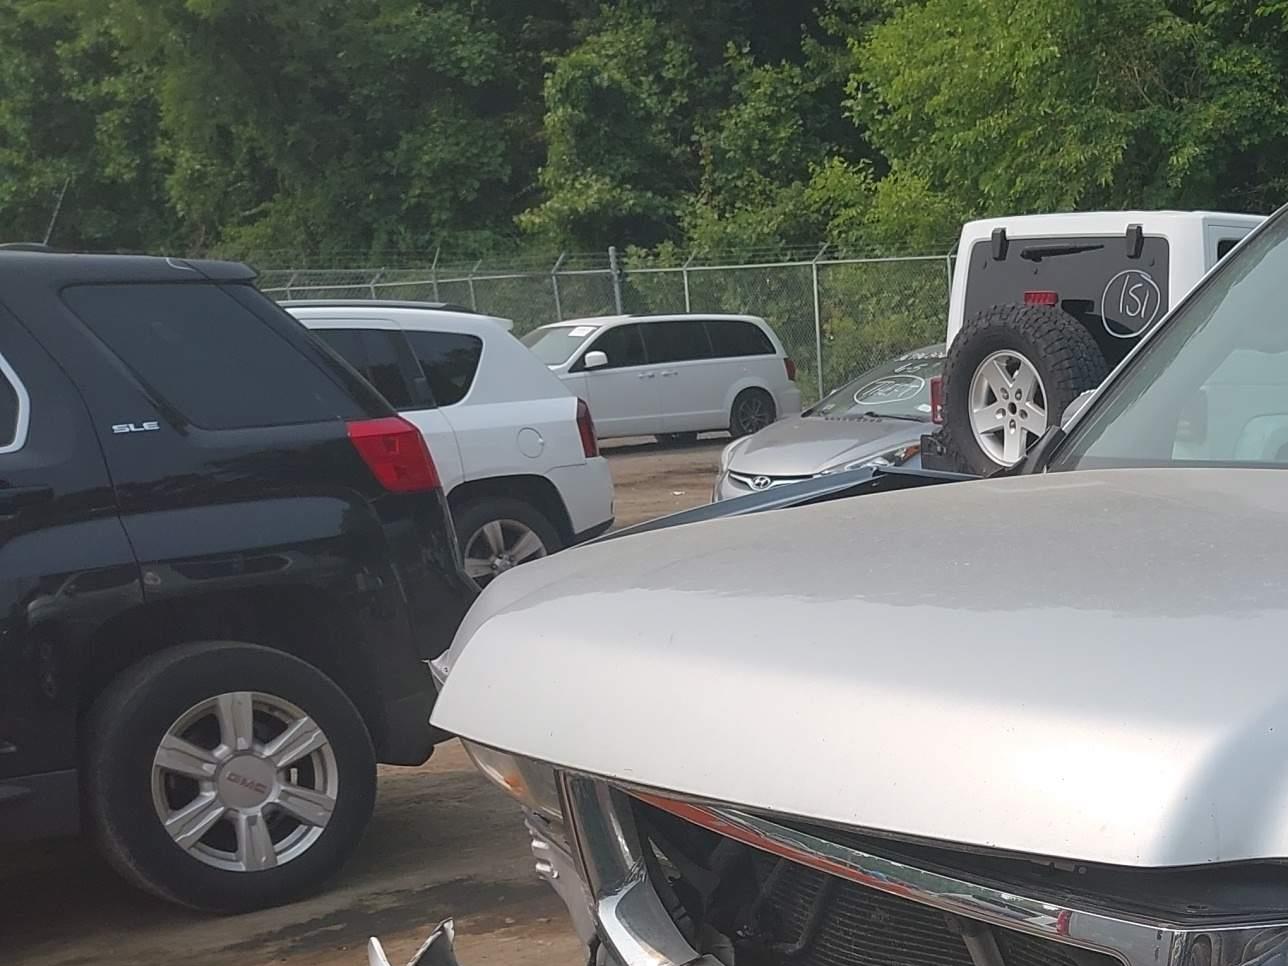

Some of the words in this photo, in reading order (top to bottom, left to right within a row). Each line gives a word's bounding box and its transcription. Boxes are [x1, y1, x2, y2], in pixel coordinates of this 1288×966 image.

[1119, 274, 1149, 319] 151
[111, 421, 160, 433] SLE
[226, 772, 268, 794] GMC
